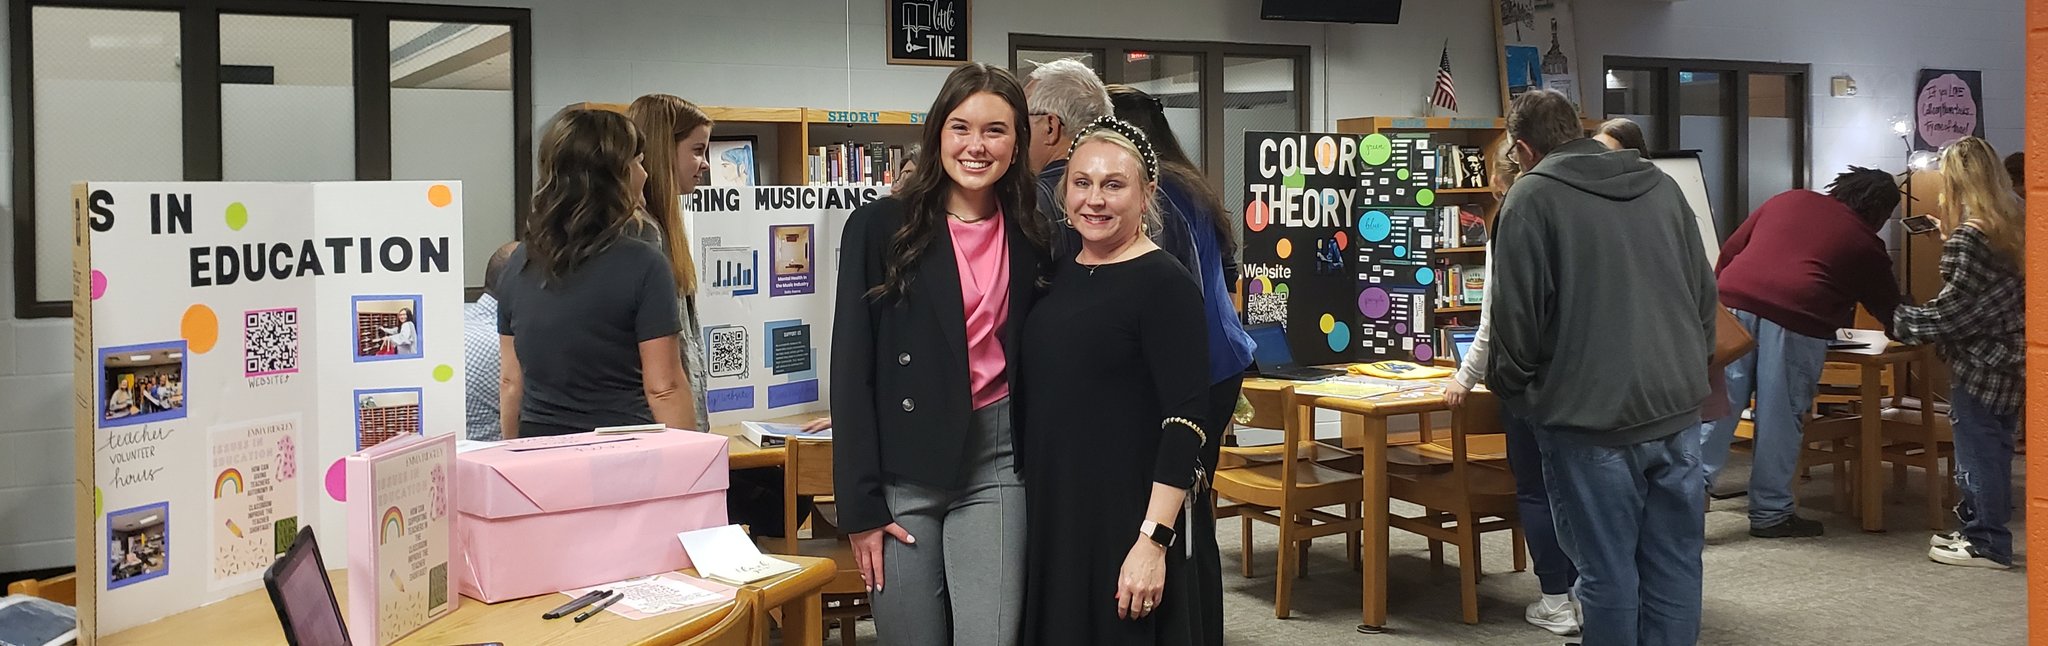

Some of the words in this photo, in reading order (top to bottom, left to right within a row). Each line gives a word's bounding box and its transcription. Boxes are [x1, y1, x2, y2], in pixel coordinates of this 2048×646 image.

[932, 0, 956, 33] little
[926, 34, 956, 58] TIME
[828, 111, 880, 123] SHORT
[910, 112, 927, 123] ST
[1259, 134, 1357, 179] COLOR
[755, 187, 878, 211] MUSICIANS
[1249, 184, 1357, 229] THEORY
[150, 193, 193, 234] IN
[190, 236, 450, 287] EDUCATION
[1243, 263, 1292, 279] Website
[98, 424, 175, 450] teacher
[109, 445, 156, 465] VOLUNTEER
[109, 467, 164, 488] hours
